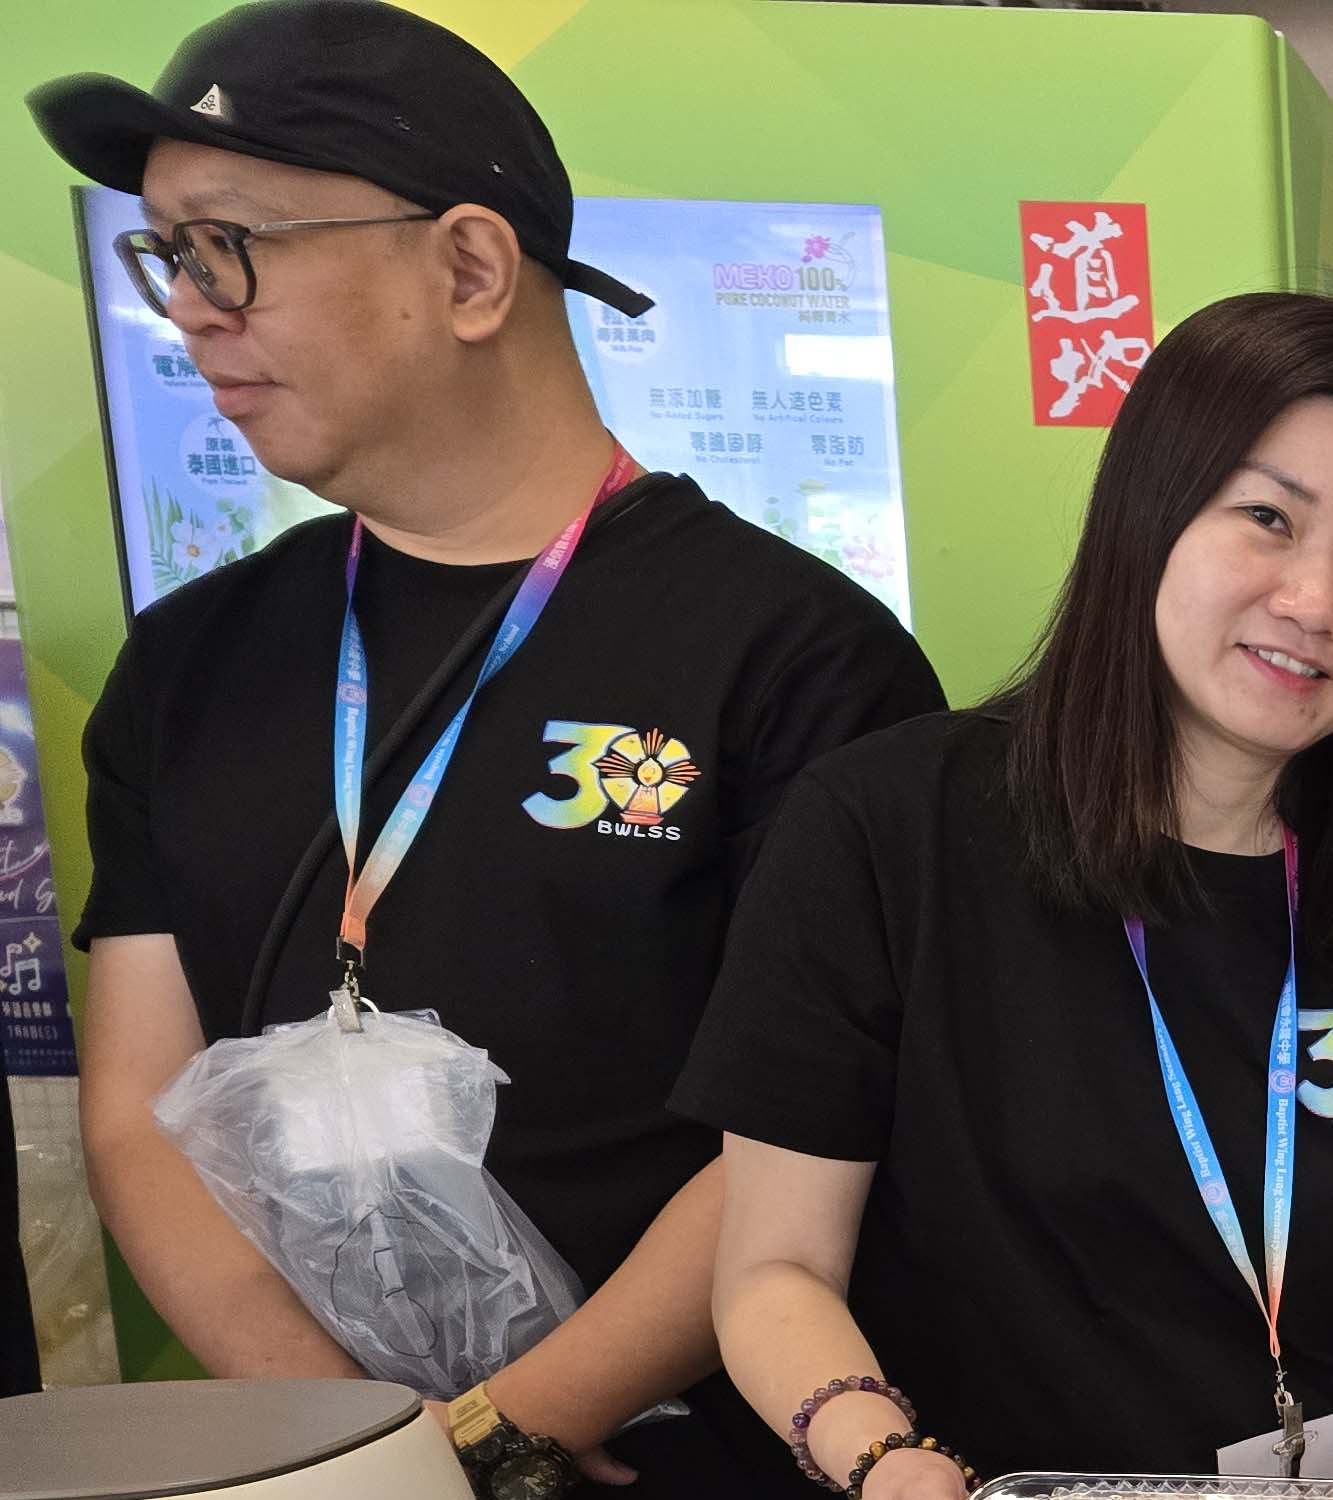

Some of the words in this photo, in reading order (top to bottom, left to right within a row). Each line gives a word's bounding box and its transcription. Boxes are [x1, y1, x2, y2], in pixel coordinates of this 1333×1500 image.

[807, 295, 849, 309] WATER
[1030, 211, 1154, 418] 道地
[752, 391, 842, 413] 無人造色素
[187, 453, 257, 476] 泰國進口
[597, 819, 682, 841] BWLSS
[1172, 1081, 1187, 1110] Lung
[1181, 1111, 1196, 1140] Wing
[1277, 1098, 1289, 1136] Baptist
[1275, 1138, 1288, 1167] Wing
[1273, 1169, 1286, 1196] Lung
